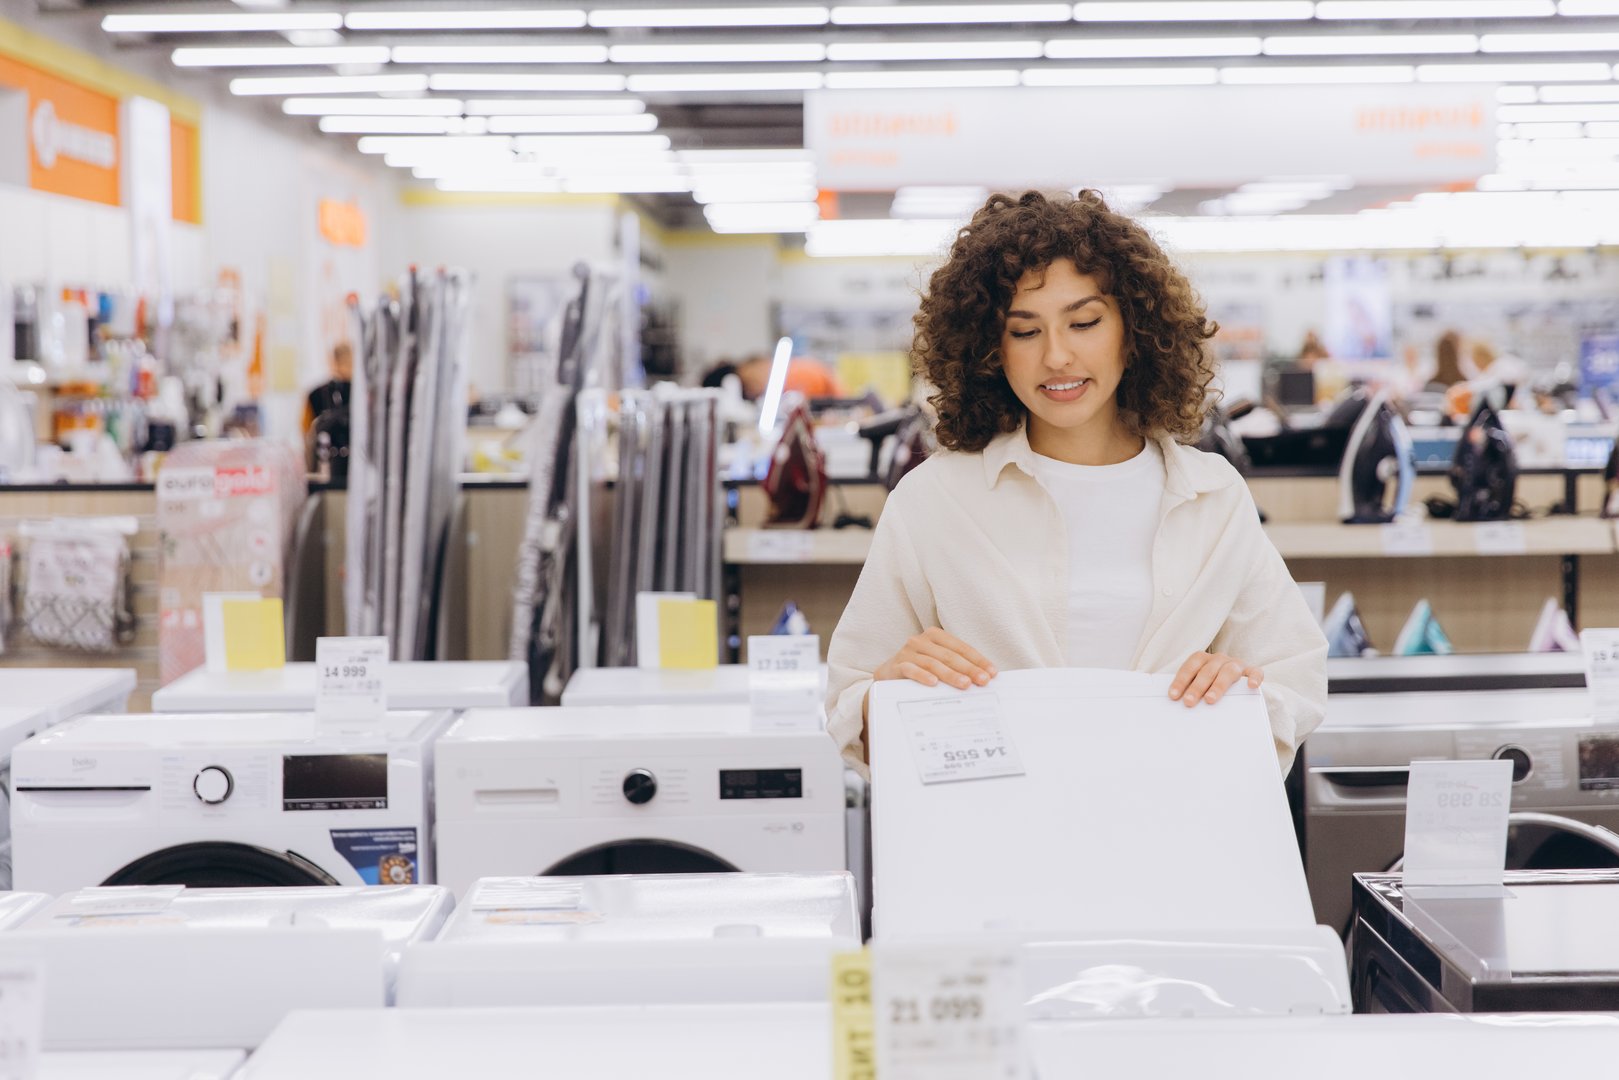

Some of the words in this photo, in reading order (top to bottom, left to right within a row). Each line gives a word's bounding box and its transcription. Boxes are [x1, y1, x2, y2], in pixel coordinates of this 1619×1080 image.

[325, 666, 339, 677] 14
[343, 665, 366, 677] 999
[944, 748, 980, 761] 555
[984, 746, 1008, 758] 14
[838, 969, 872, 1005] 10
[890, 996, 920, 1023] 21
